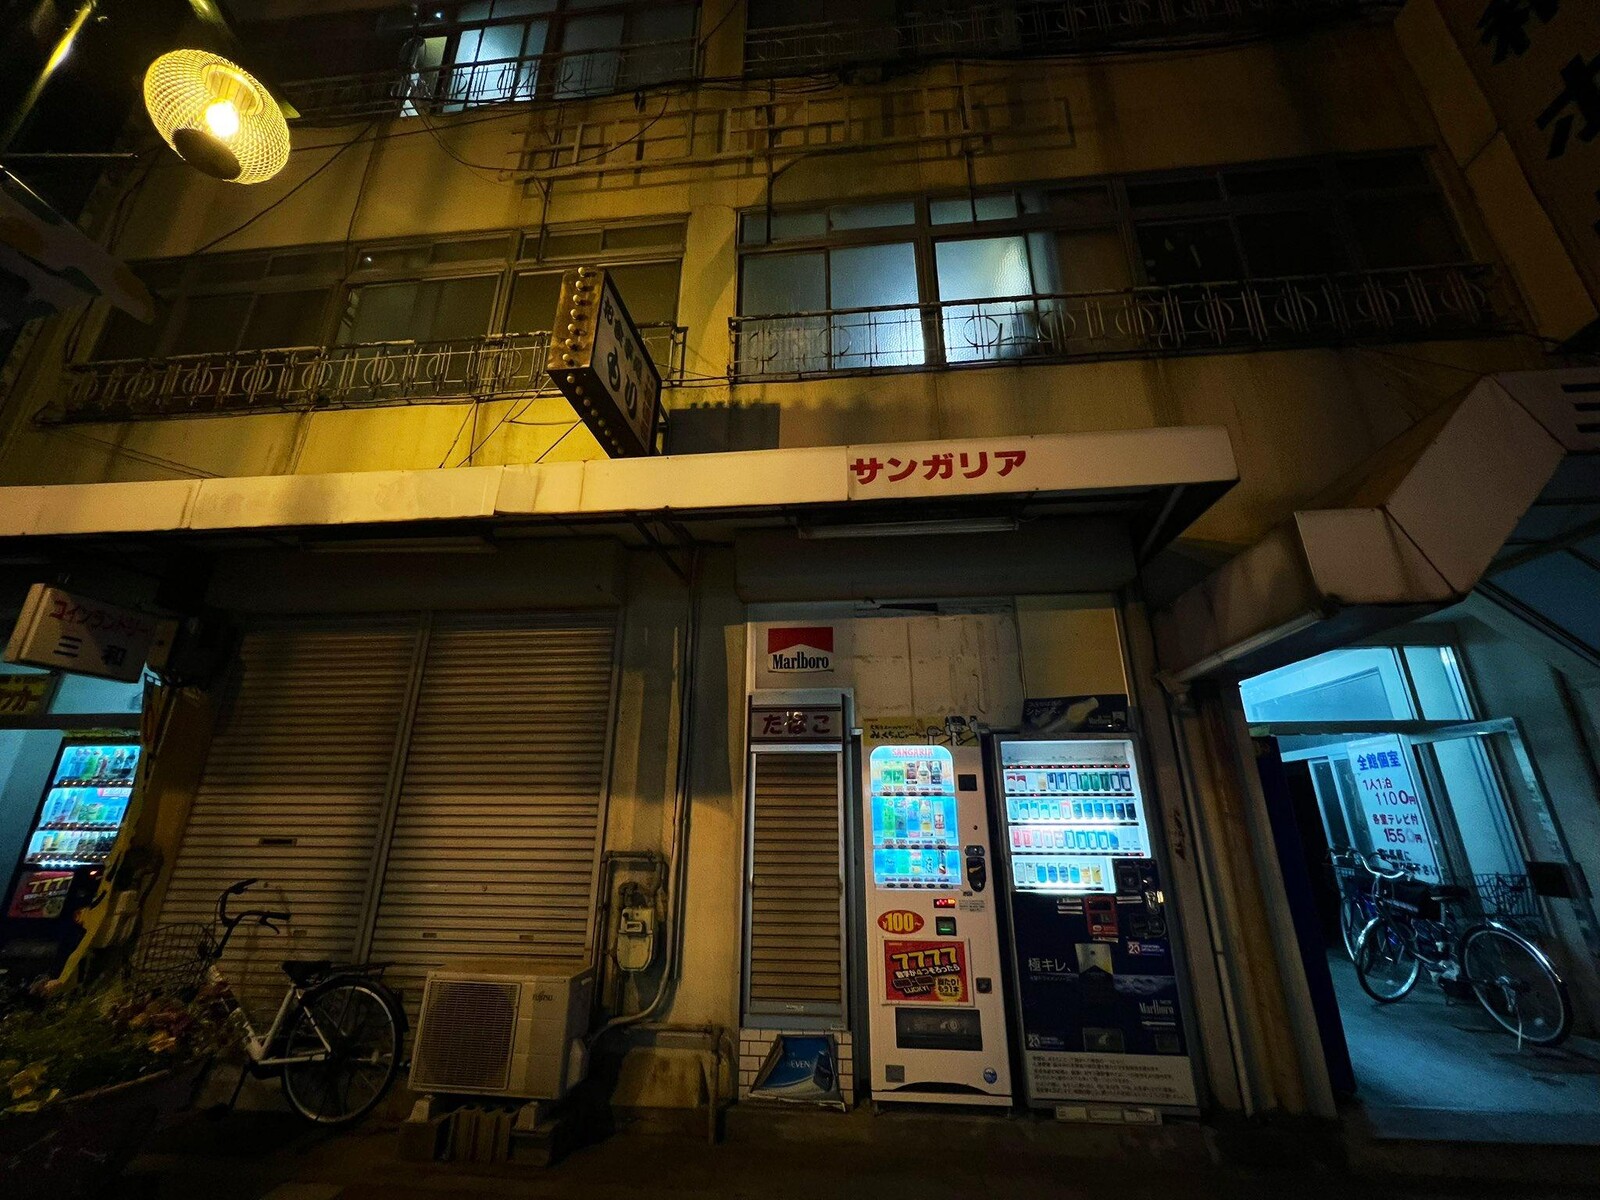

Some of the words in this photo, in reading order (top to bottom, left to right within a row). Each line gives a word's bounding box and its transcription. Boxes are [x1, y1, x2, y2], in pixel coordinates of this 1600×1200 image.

[850, 450, 1026, 485] サンガリア
[772, 652, 829, 669] Marlboro
[763, 712, 830, 735] たばこ
[892, 748, 933, 757] SANGARIA
[1357, 750, 1401, 771] 全館個室
[1363, 777, 1392, 790] 1人1泊
[1372, 813, 1419, 825] 各室テレビ付
[892, 947, 957, 970] 7777
